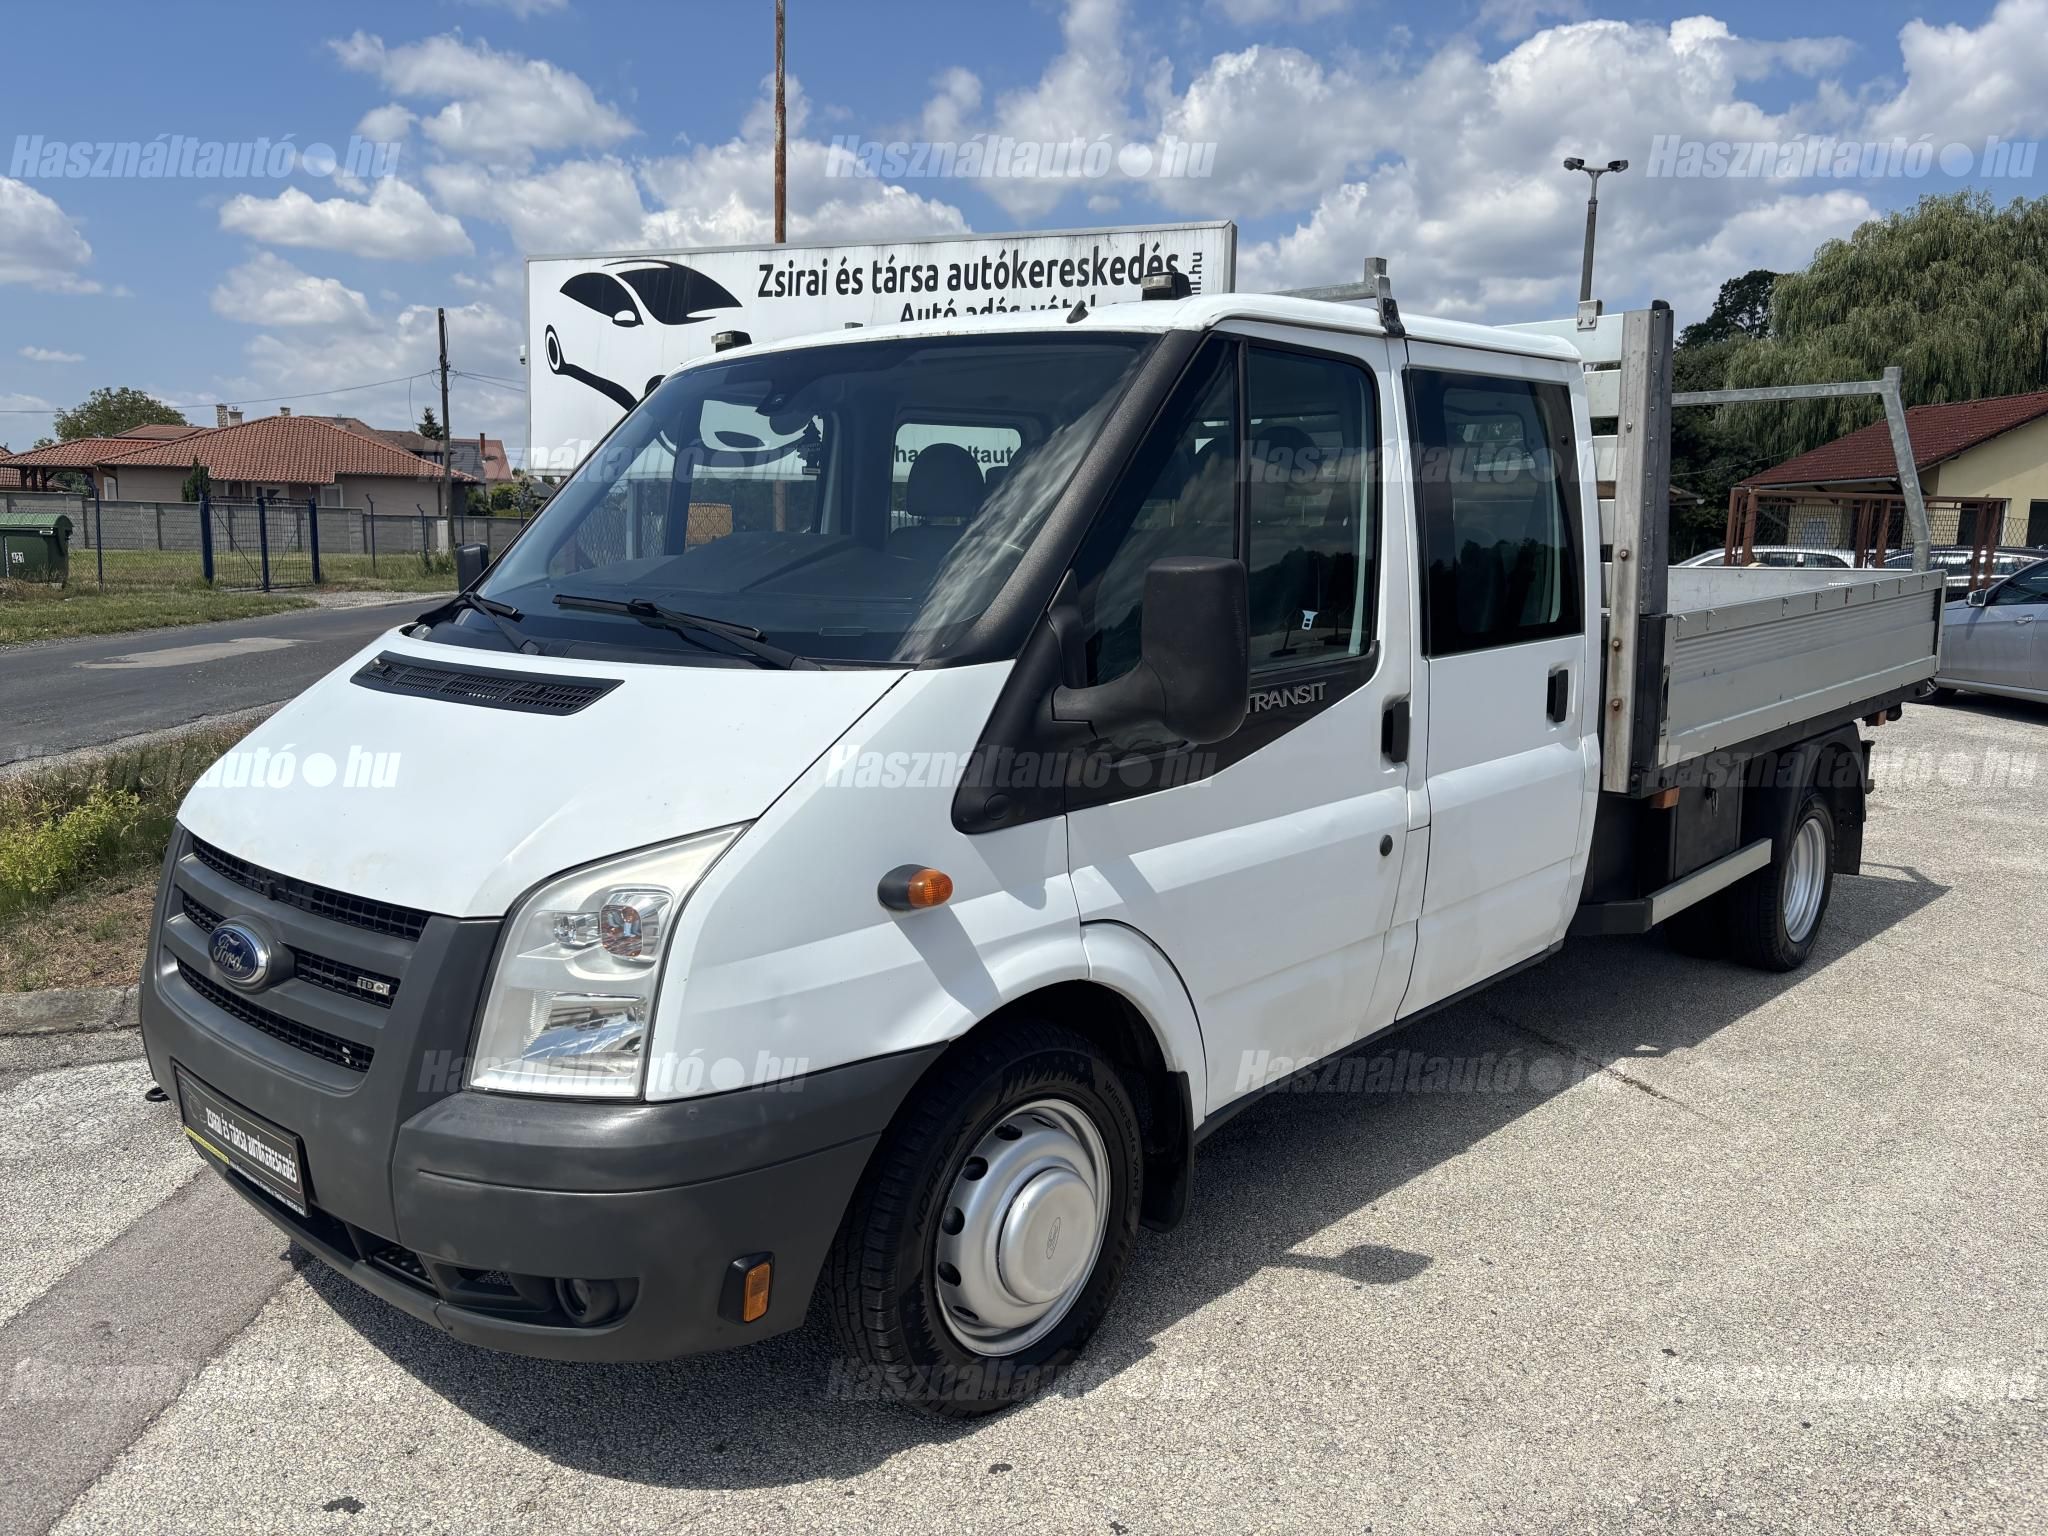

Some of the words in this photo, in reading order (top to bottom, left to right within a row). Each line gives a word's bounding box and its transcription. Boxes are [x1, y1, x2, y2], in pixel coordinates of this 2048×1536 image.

[757, 258, 828, 298] Zsirai
[835, 256, 864, 296] és
[871, 253, 939, 294] társa
[947, 241, 1179, 291] autókereskedés
